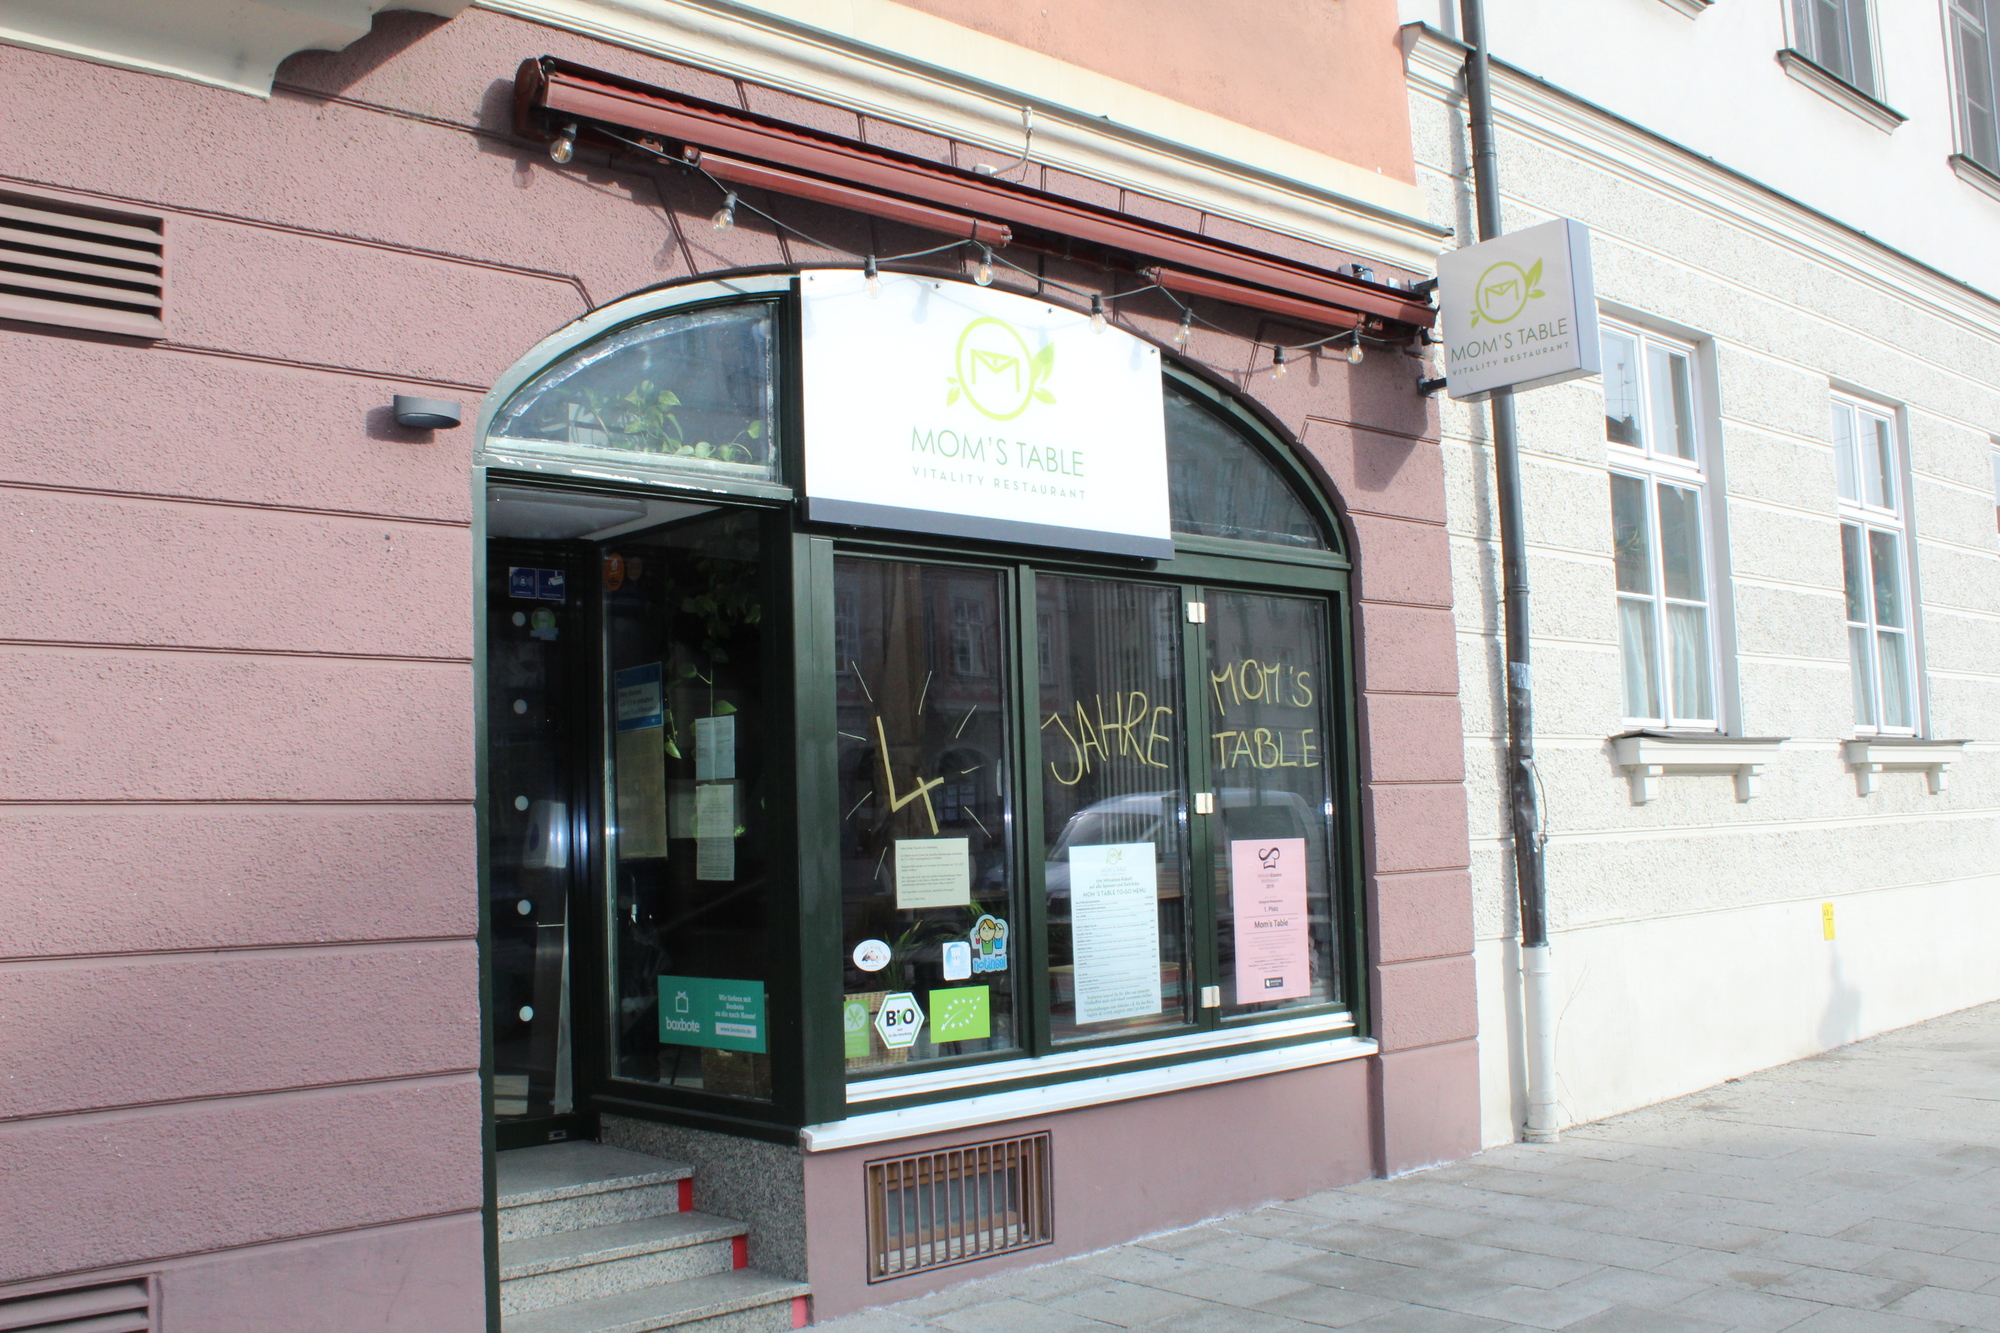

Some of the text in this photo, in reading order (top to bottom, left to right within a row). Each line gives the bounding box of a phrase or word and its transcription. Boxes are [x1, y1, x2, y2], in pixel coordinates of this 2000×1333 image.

[1451, 317, 1568, 363] MOM'S TABLE
[1452, 341, 1570, 376] VITALITY RESTAURANT
[911, 425, 1084, 477] MOM'S TABLE
[912, 465, 1085, 500] VITALITY RESTAURANT
[1039, 690, 1173, 786] JAHRE
[1211, 727, 1320, 770] TABLE
[876, 715, 945, 836] 4
[1254, 919, 1289, 929] Mom's Table
[665, 1016, 700, 1033] boxbote
